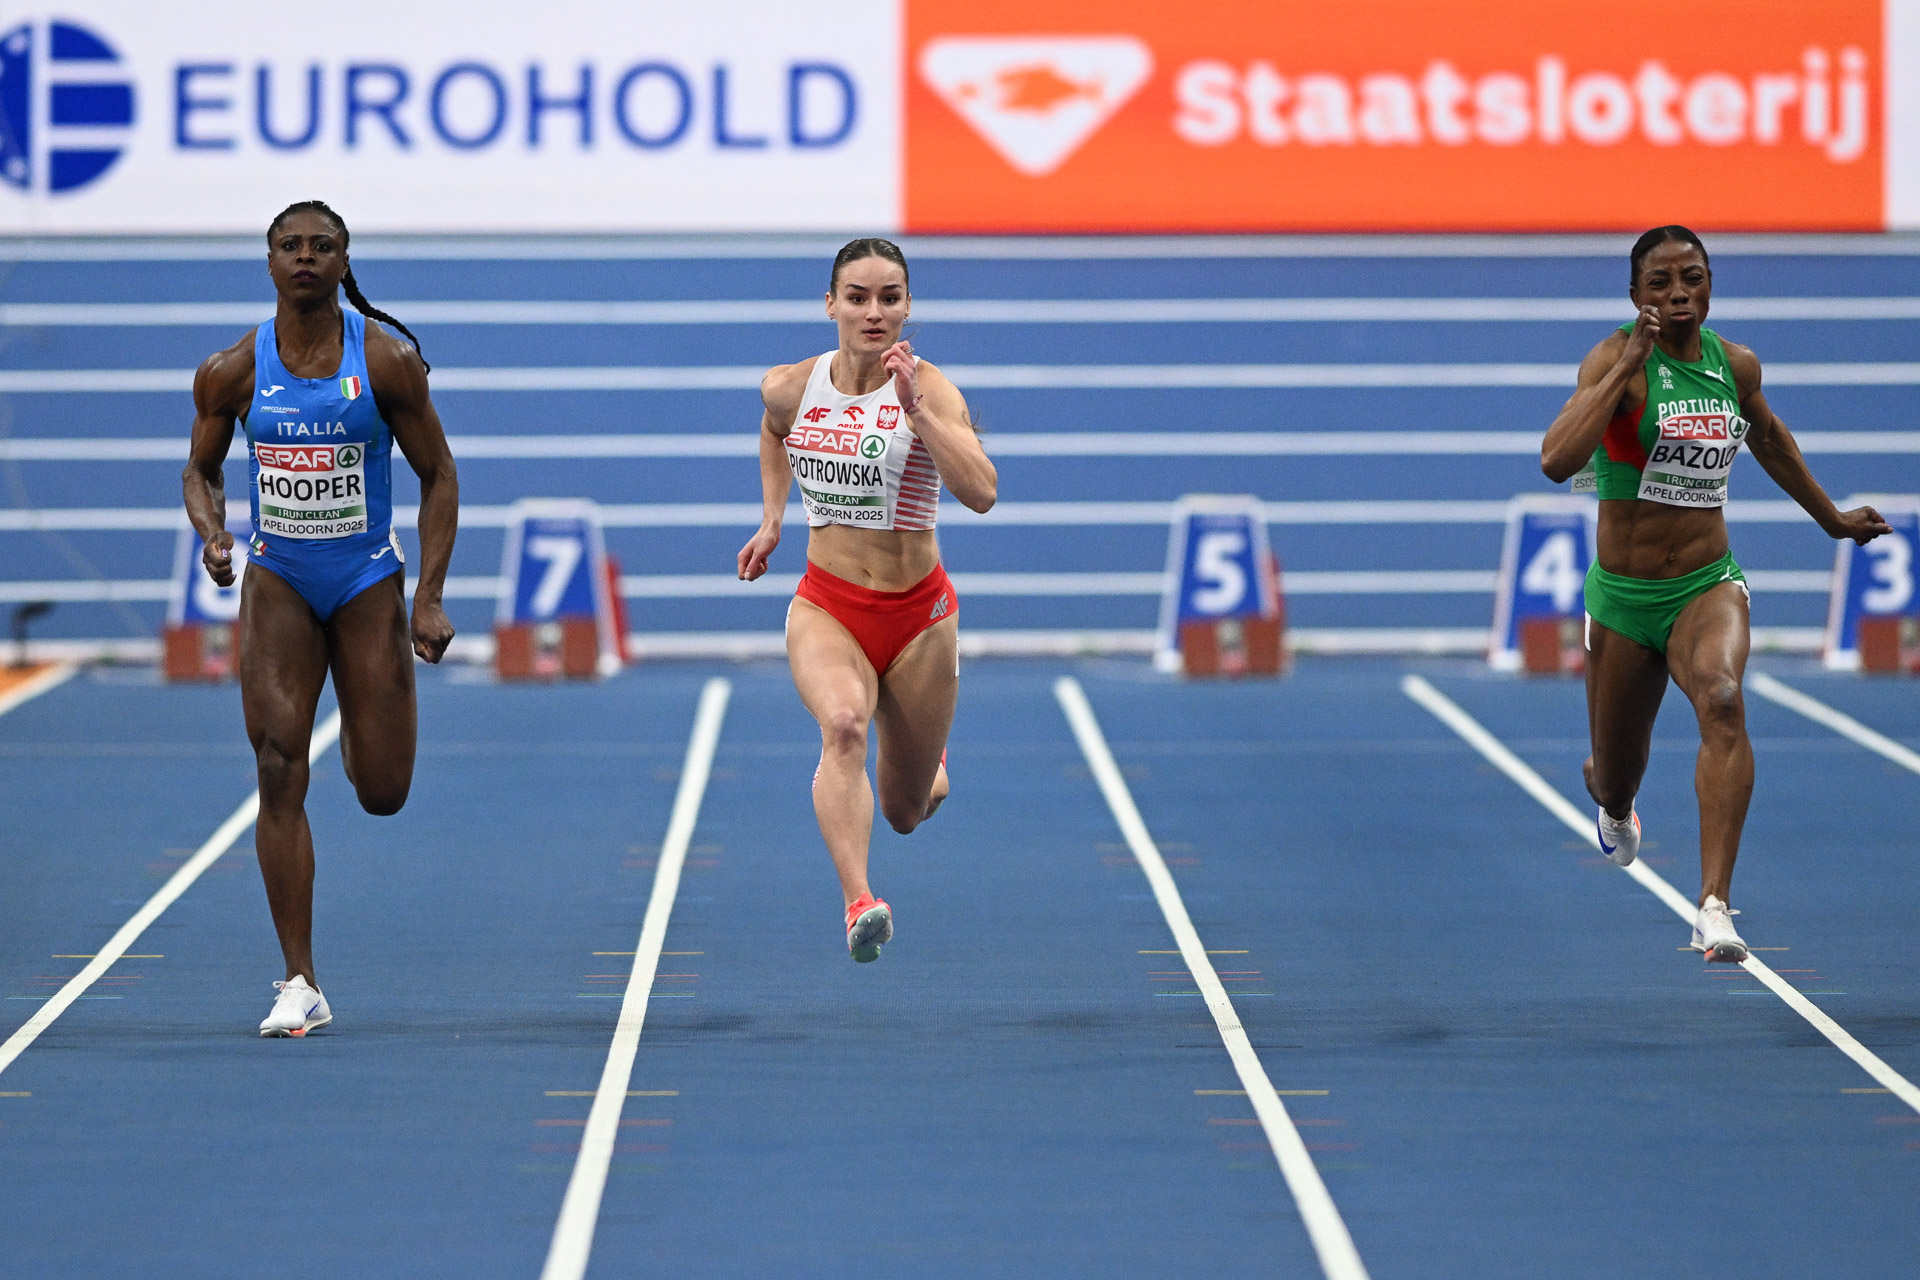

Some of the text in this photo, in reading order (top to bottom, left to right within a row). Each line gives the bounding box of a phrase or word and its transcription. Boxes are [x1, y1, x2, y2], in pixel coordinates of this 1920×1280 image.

[172, 61, 860, 151] EUROHOLD
[1174, 46, 1868, 163] Staatsloterij
[803, 406, 832, 423] 4F
[277, 421, 347, 436] ITALIA
[1663, 418, 1726, 437] SPAR
[787, 428, 858, 453] SPAR
[257, 448, 333, 469] SPAR
[790, 453, 884, 487] PIOTROWSKA
[1651, 445, 1738, 470] BAZOLO
[259, 473, 362, 501] HOOPER
[1642, 485, 1715, 502] APELDOORN
[1671, 475, 1695, 487] RUN
[826, 494, 859, 505] CLEAN
[278, 508, 340, 520] I RUN CLEAN
[854, 510, 884, 521] 2025
[263, 519, 364, 535] APELDOORN 2025
[526, 536, 583, 617] 7
[1192, 532, 1251, 613] 5
[1521, 531, 1585, 612] 4
[1862, 532, 1915, 613] 3
[929, 591, 949, 620] 4F
